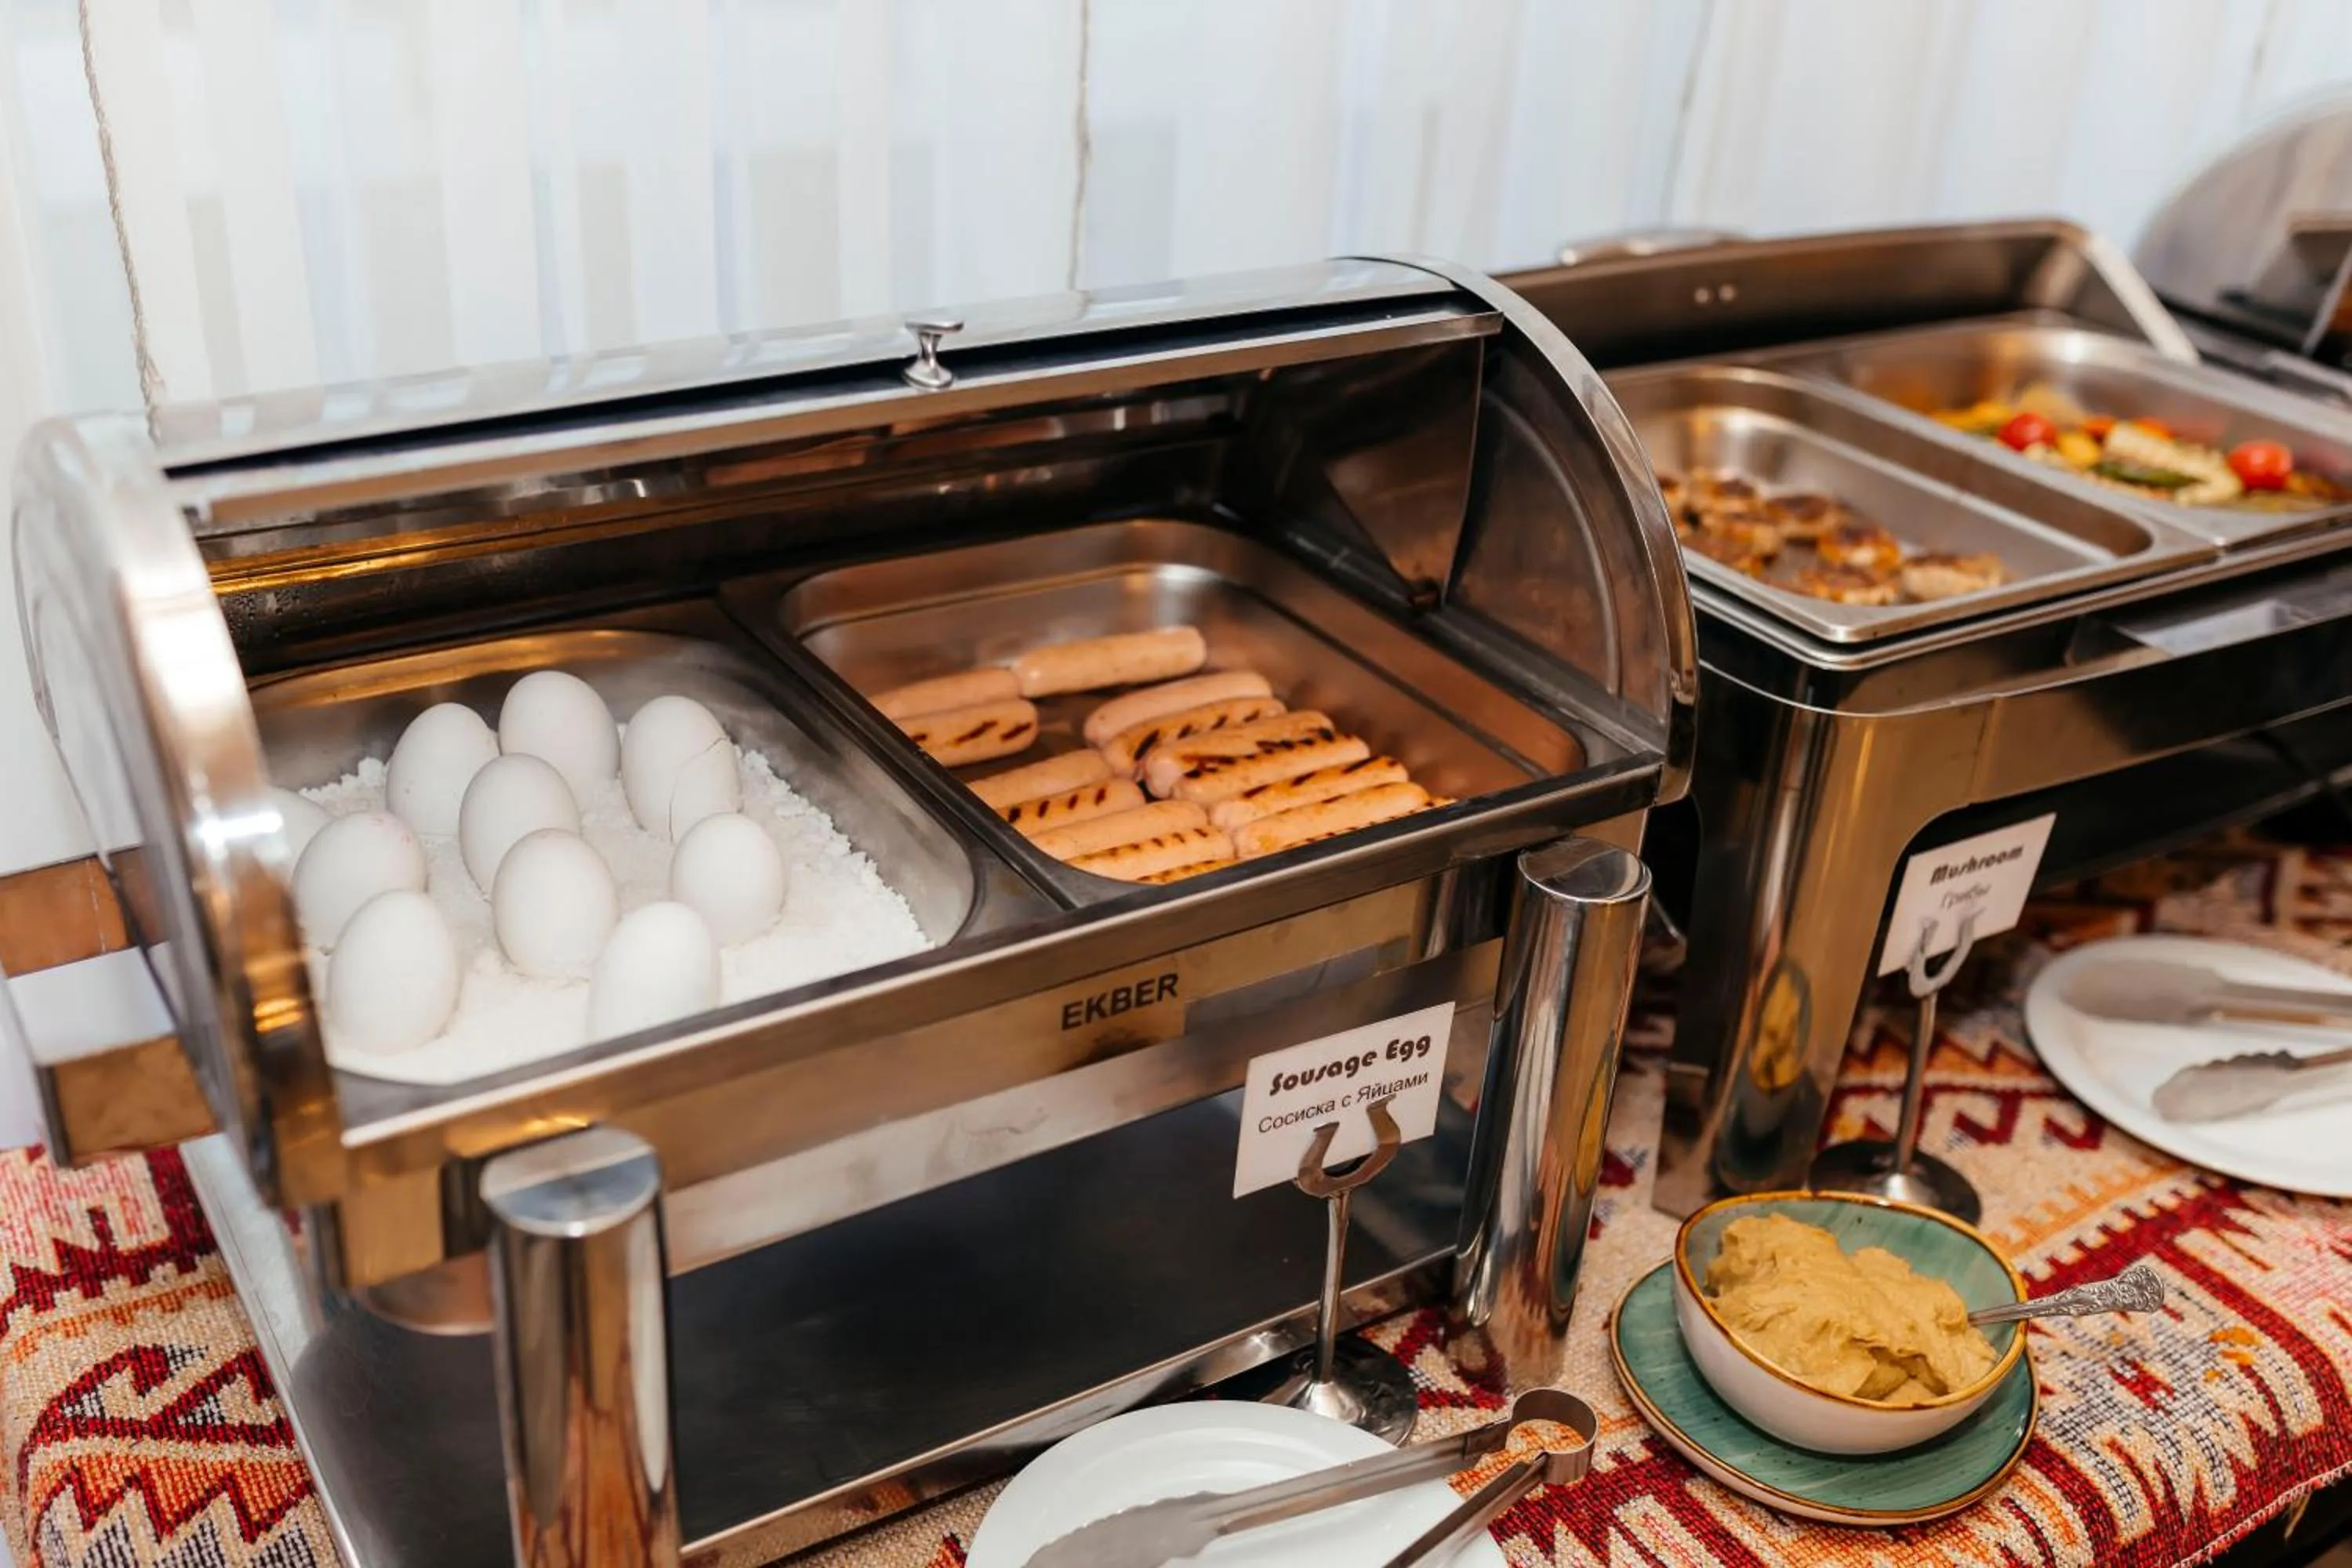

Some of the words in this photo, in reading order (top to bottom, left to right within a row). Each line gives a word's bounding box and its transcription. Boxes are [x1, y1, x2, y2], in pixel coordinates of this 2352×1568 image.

[1929, 845, 2024, 886] Mushroom
[1062, 973, 1179, 1031] EKBER
[1269, 1051, 1377, 1095] Sousage
[1385, 1035, 1432, 1062] Egg
[1258, 1099, 1335, 1134] Сосиска
[1341, 1095, 1352, 1108] с
[1356, 1072, 1428, 1102] Яйцами
